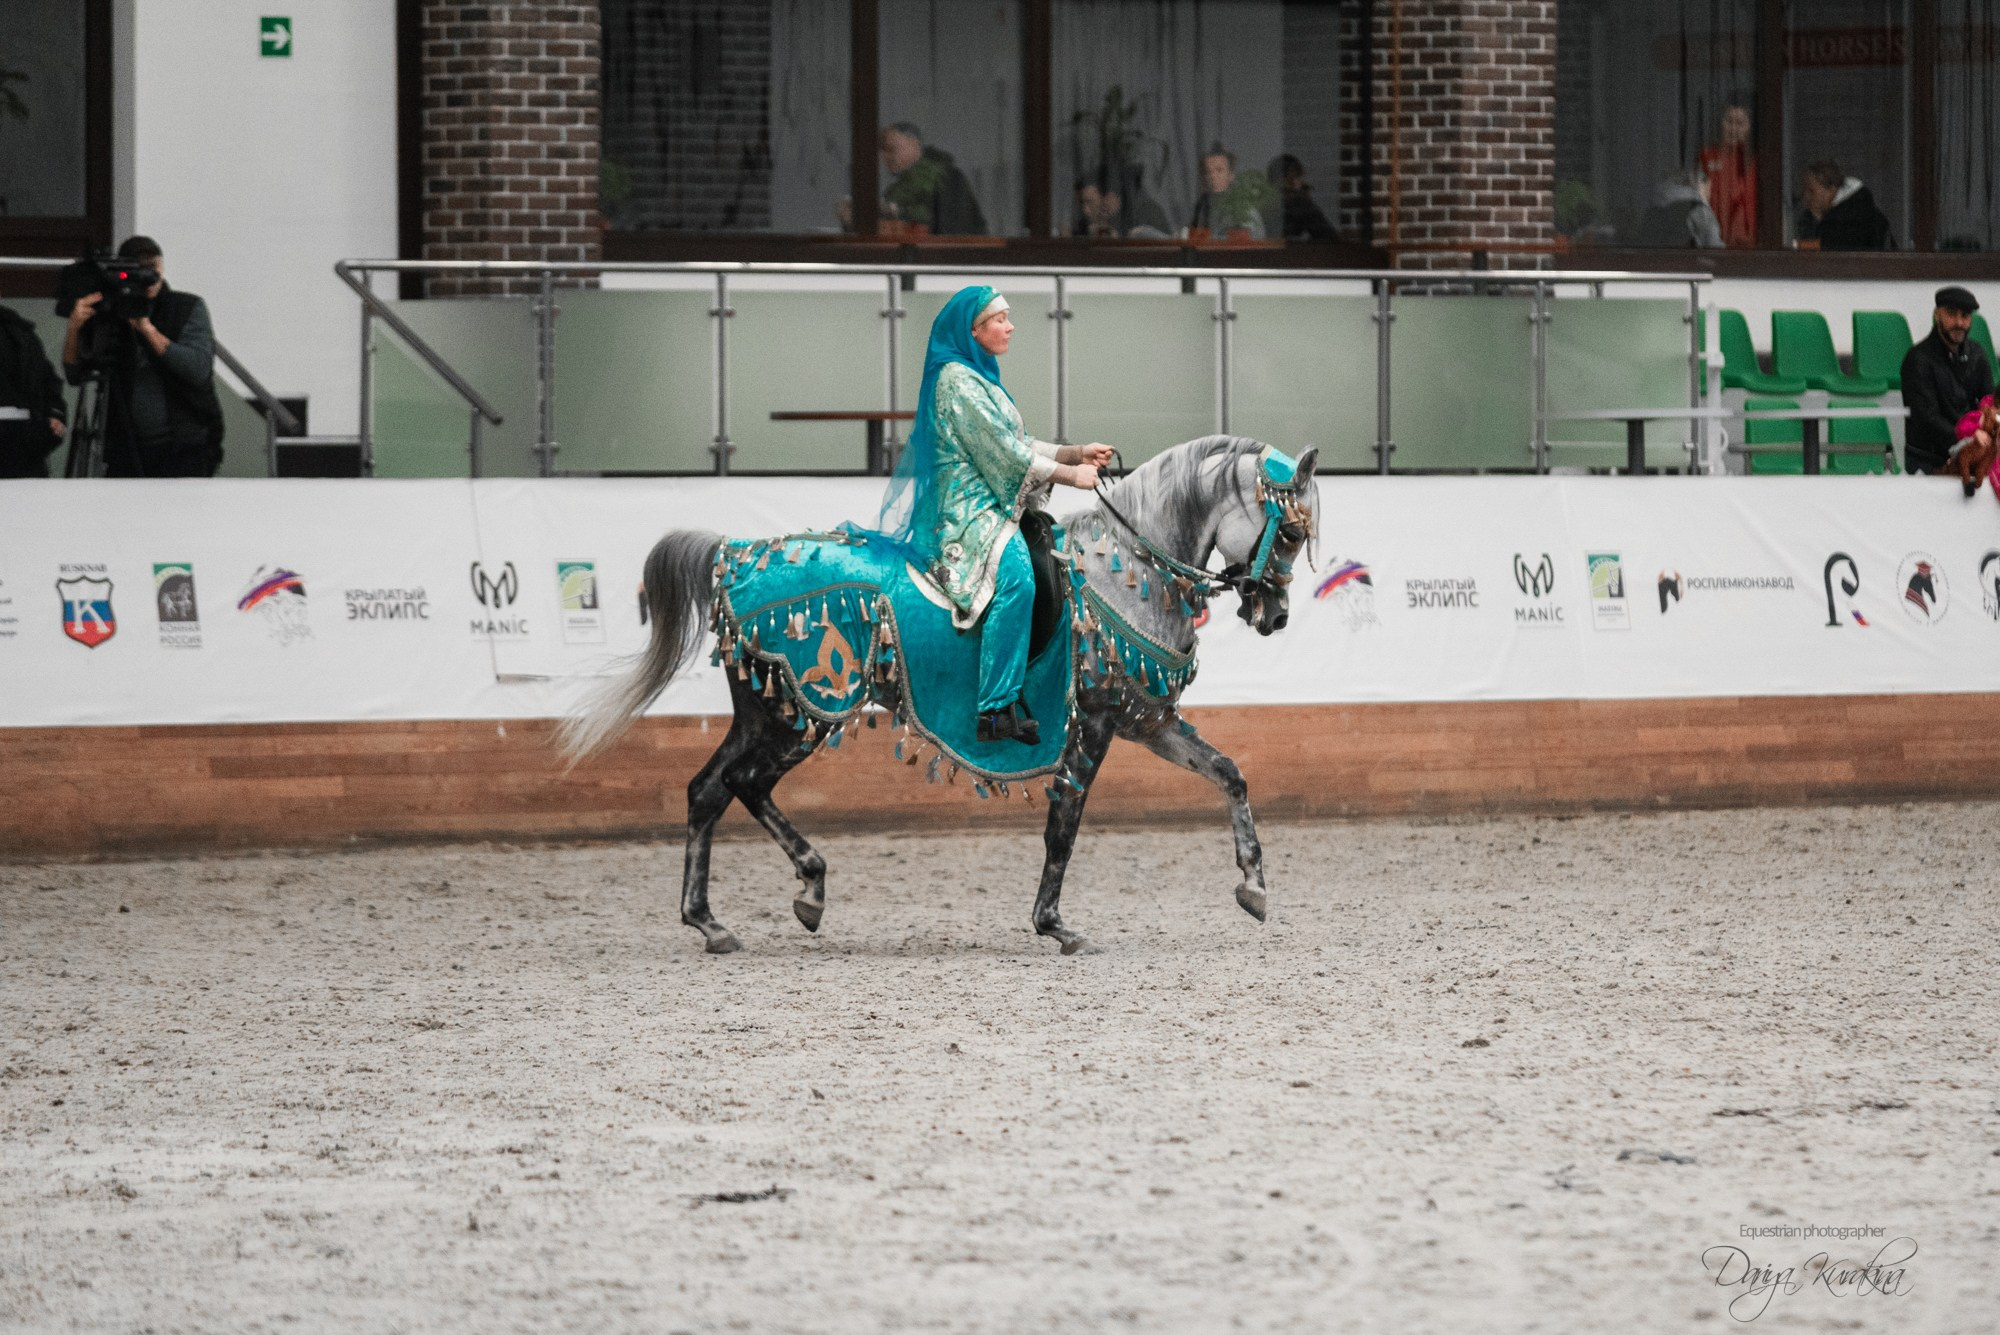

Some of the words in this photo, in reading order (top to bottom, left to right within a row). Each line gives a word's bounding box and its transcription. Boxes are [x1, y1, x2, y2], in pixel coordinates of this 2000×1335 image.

[1406, 577, 1476, 590] КРЫЛАТЫЙ
[1687, 576, 1795, 590] РОСПЛЕМКОНЗАВОД
[345, 587, 427, 600] КРЫЛАТЫЙ
[1407, 591, 1479, 608] ЭКЛИПС
[346, 602, 429, 620] ЭКЛИПС
